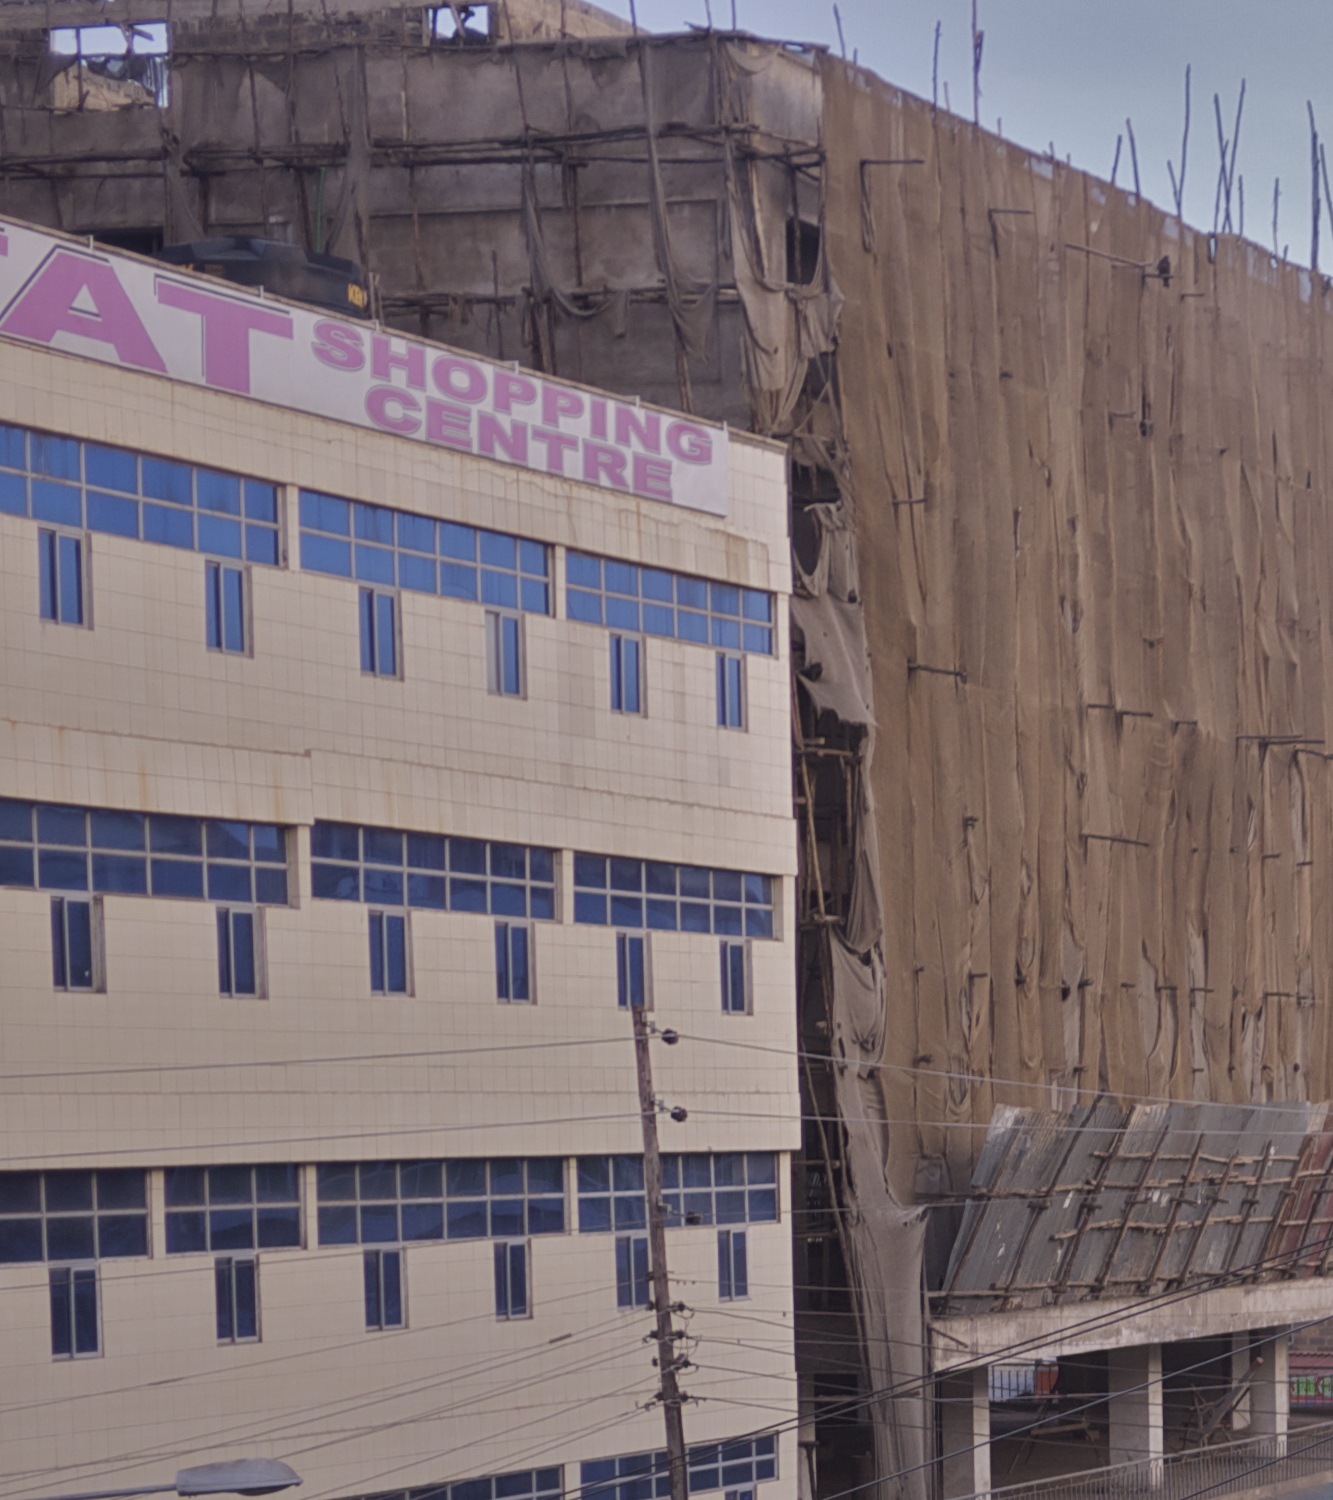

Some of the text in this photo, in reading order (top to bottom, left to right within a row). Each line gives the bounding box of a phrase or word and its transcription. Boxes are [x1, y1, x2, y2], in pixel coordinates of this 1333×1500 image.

[0, 228, 713, 466] AT SHOPPING
[364, 384, 673, 502] CENTRE
